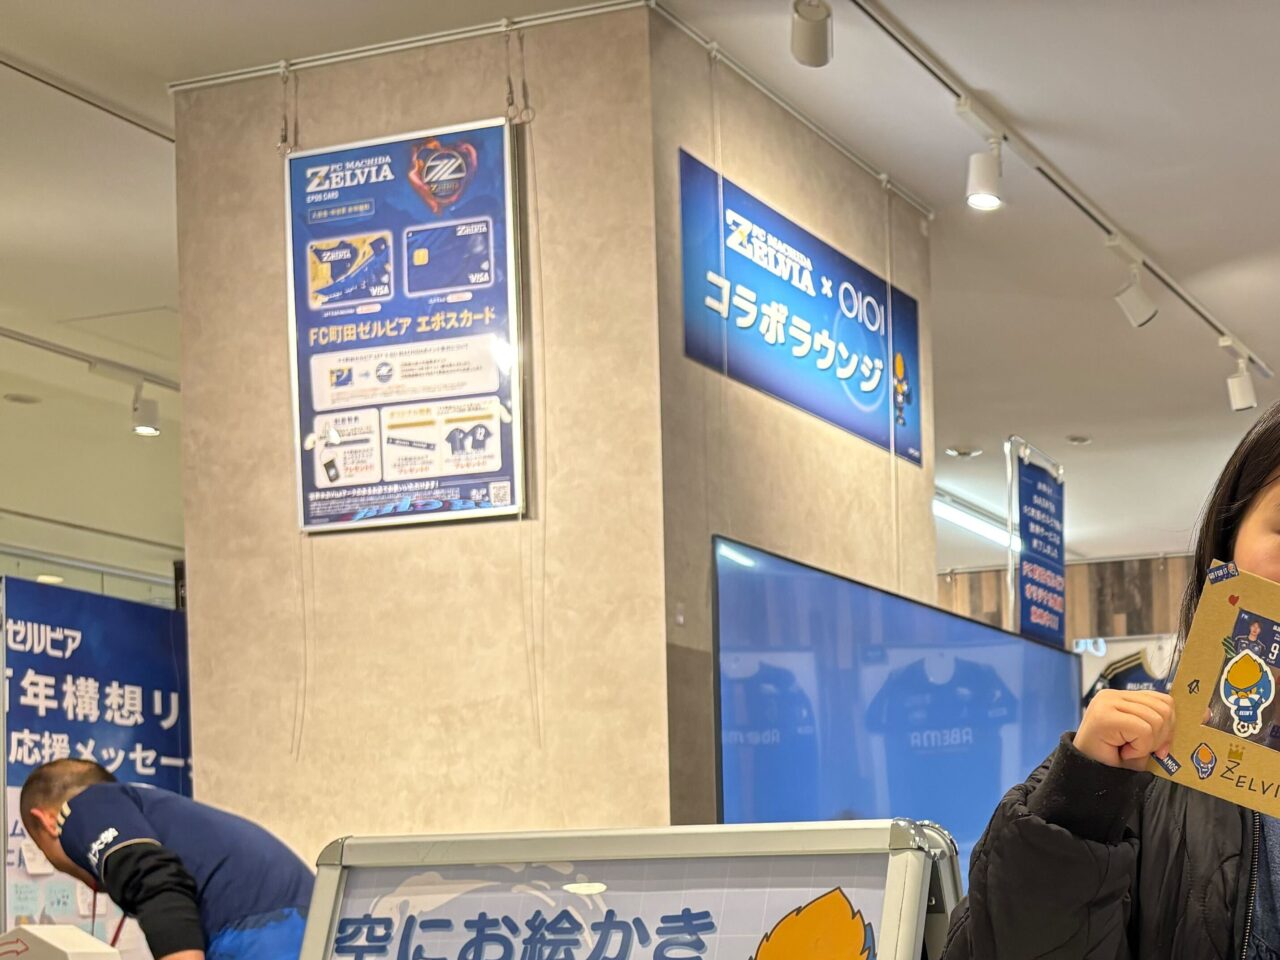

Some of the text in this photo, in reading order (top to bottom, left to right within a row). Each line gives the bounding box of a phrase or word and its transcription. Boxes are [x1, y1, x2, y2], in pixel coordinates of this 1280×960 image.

[305, 164, 396, 193] ZELVIA
[726, 208, 817, 297] ZELVIA
[309, 305, 496, 347] FC町田ゼルビア エポスカード
[704, 270, 884, 393] コラボラウンジ
[1268, 642, 1280, 660] 9
[9, 728, 193, 776] 応援メッセー
